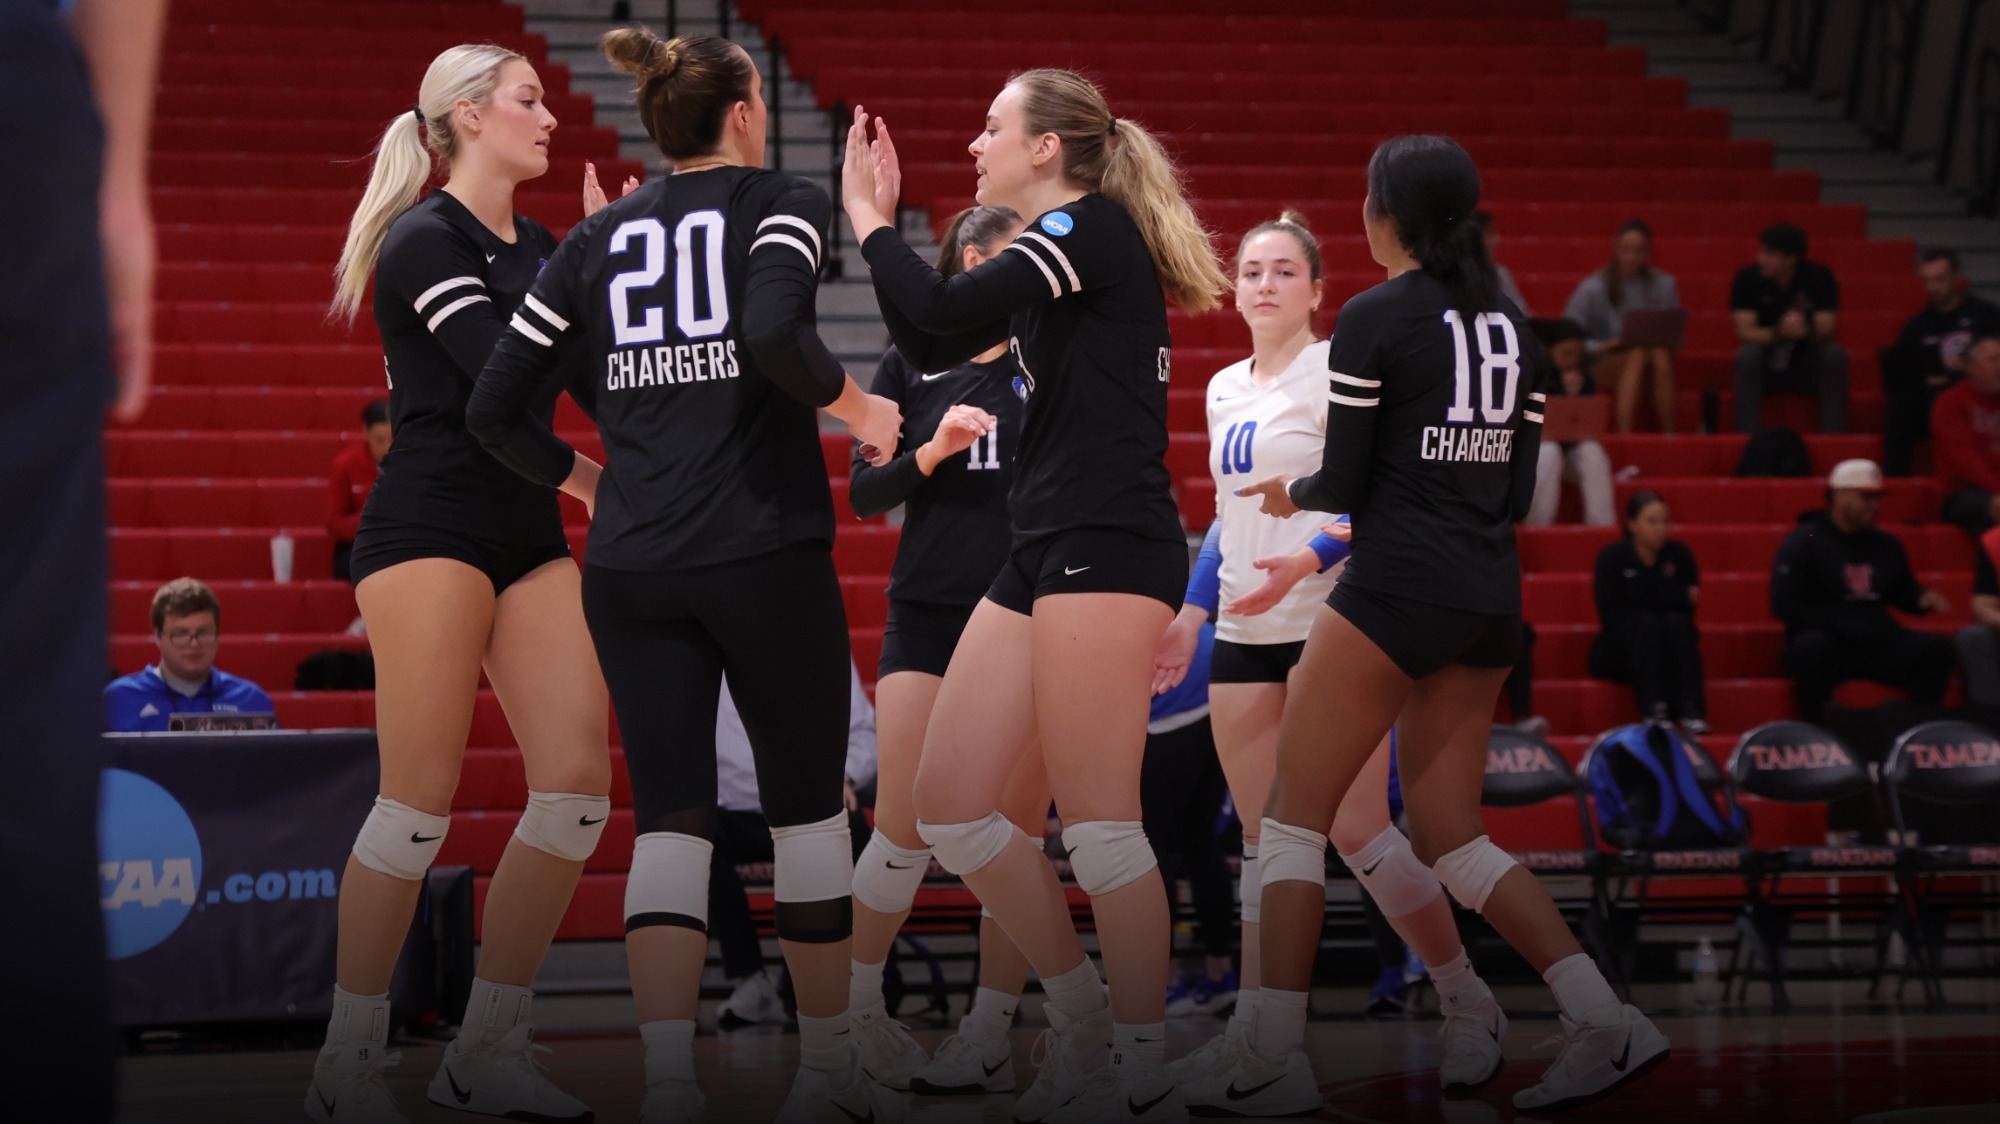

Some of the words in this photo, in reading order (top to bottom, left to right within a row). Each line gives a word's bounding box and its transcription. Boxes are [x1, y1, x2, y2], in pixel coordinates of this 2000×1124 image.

[1044, 219, 1069, 236] NCAA
[608, 208, 730, 347] 20
[607, 339, 740, 391] CHARGERS
[1442, 309, 1521, 425] 18
[967, 418, 1001, 470] 11
[1221, 421, 1258, 475] 10
[1484, 746, 1557, 774] MPA
[1746, 742, 1853, 771] TAMPA
[97, 857, 197, 909] CAA
